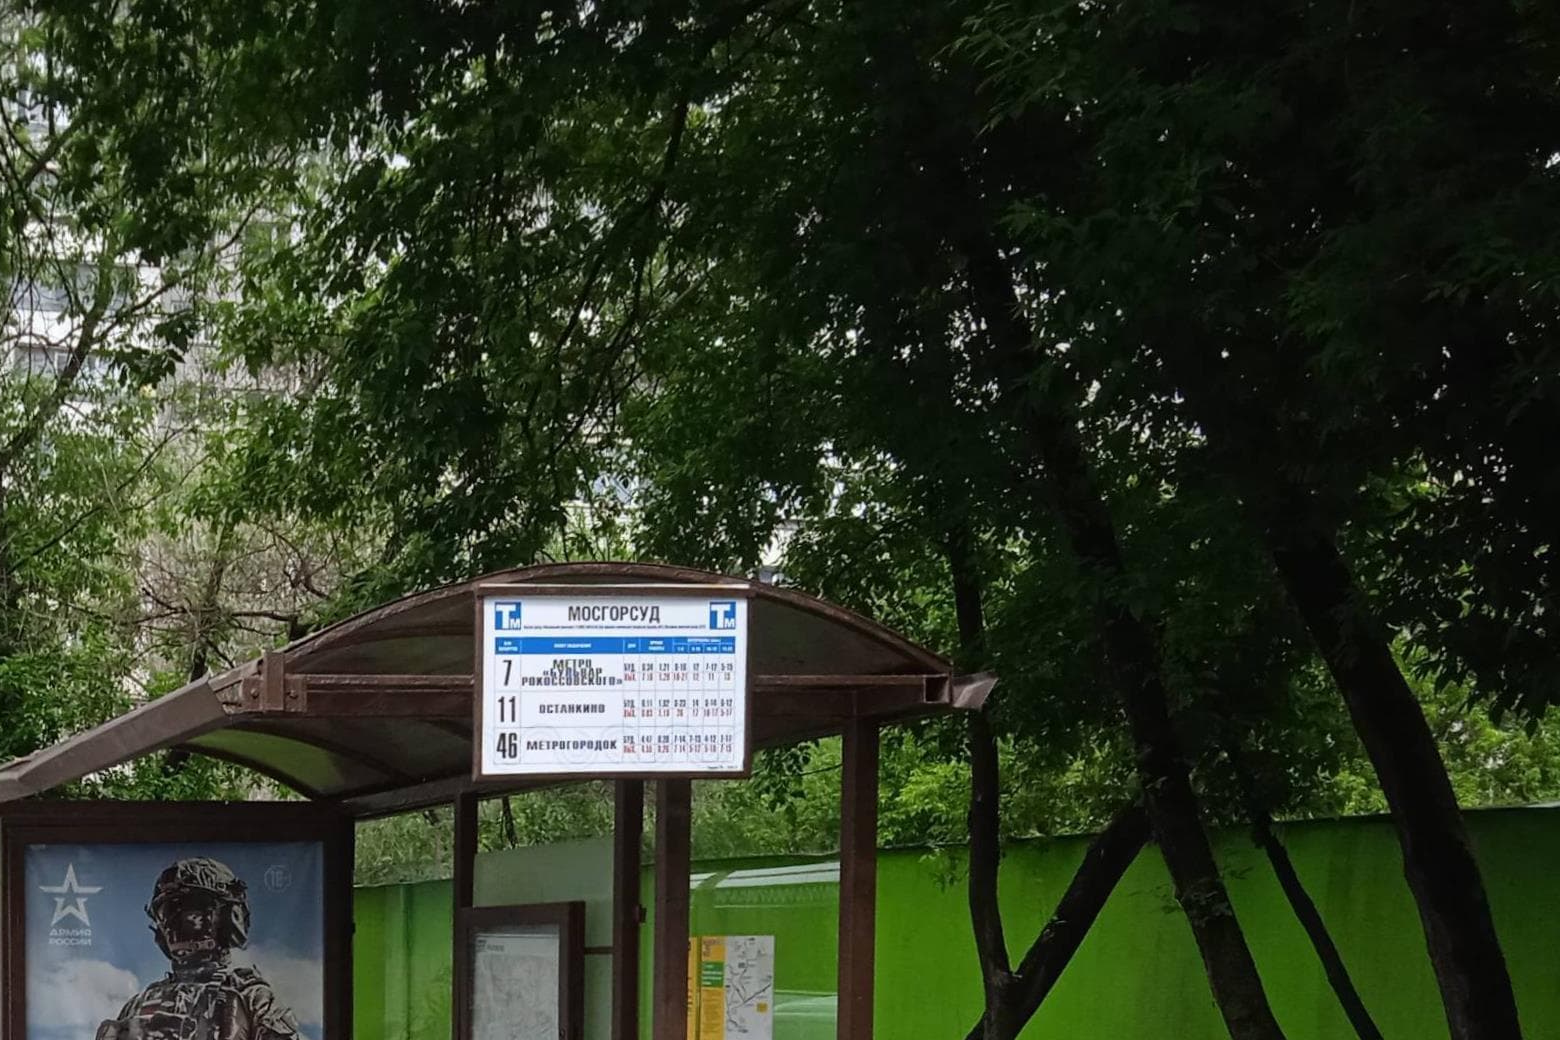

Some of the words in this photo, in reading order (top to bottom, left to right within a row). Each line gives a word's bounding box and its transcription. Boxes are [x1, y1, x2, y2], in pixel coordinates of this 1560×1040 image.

[567, 605, 661, 624] МОСГОРСУД
[502, 659, 513, 687] 7
[552, 658, 592, 670] МЕТРО
[497, 695, 517, 723] 11
[539, 703, 606, 714] ОСТАНКИНО
[496, 732, 518, 759] 46
[526, 739, 618, 752] МЕТРОГОРОДОК
